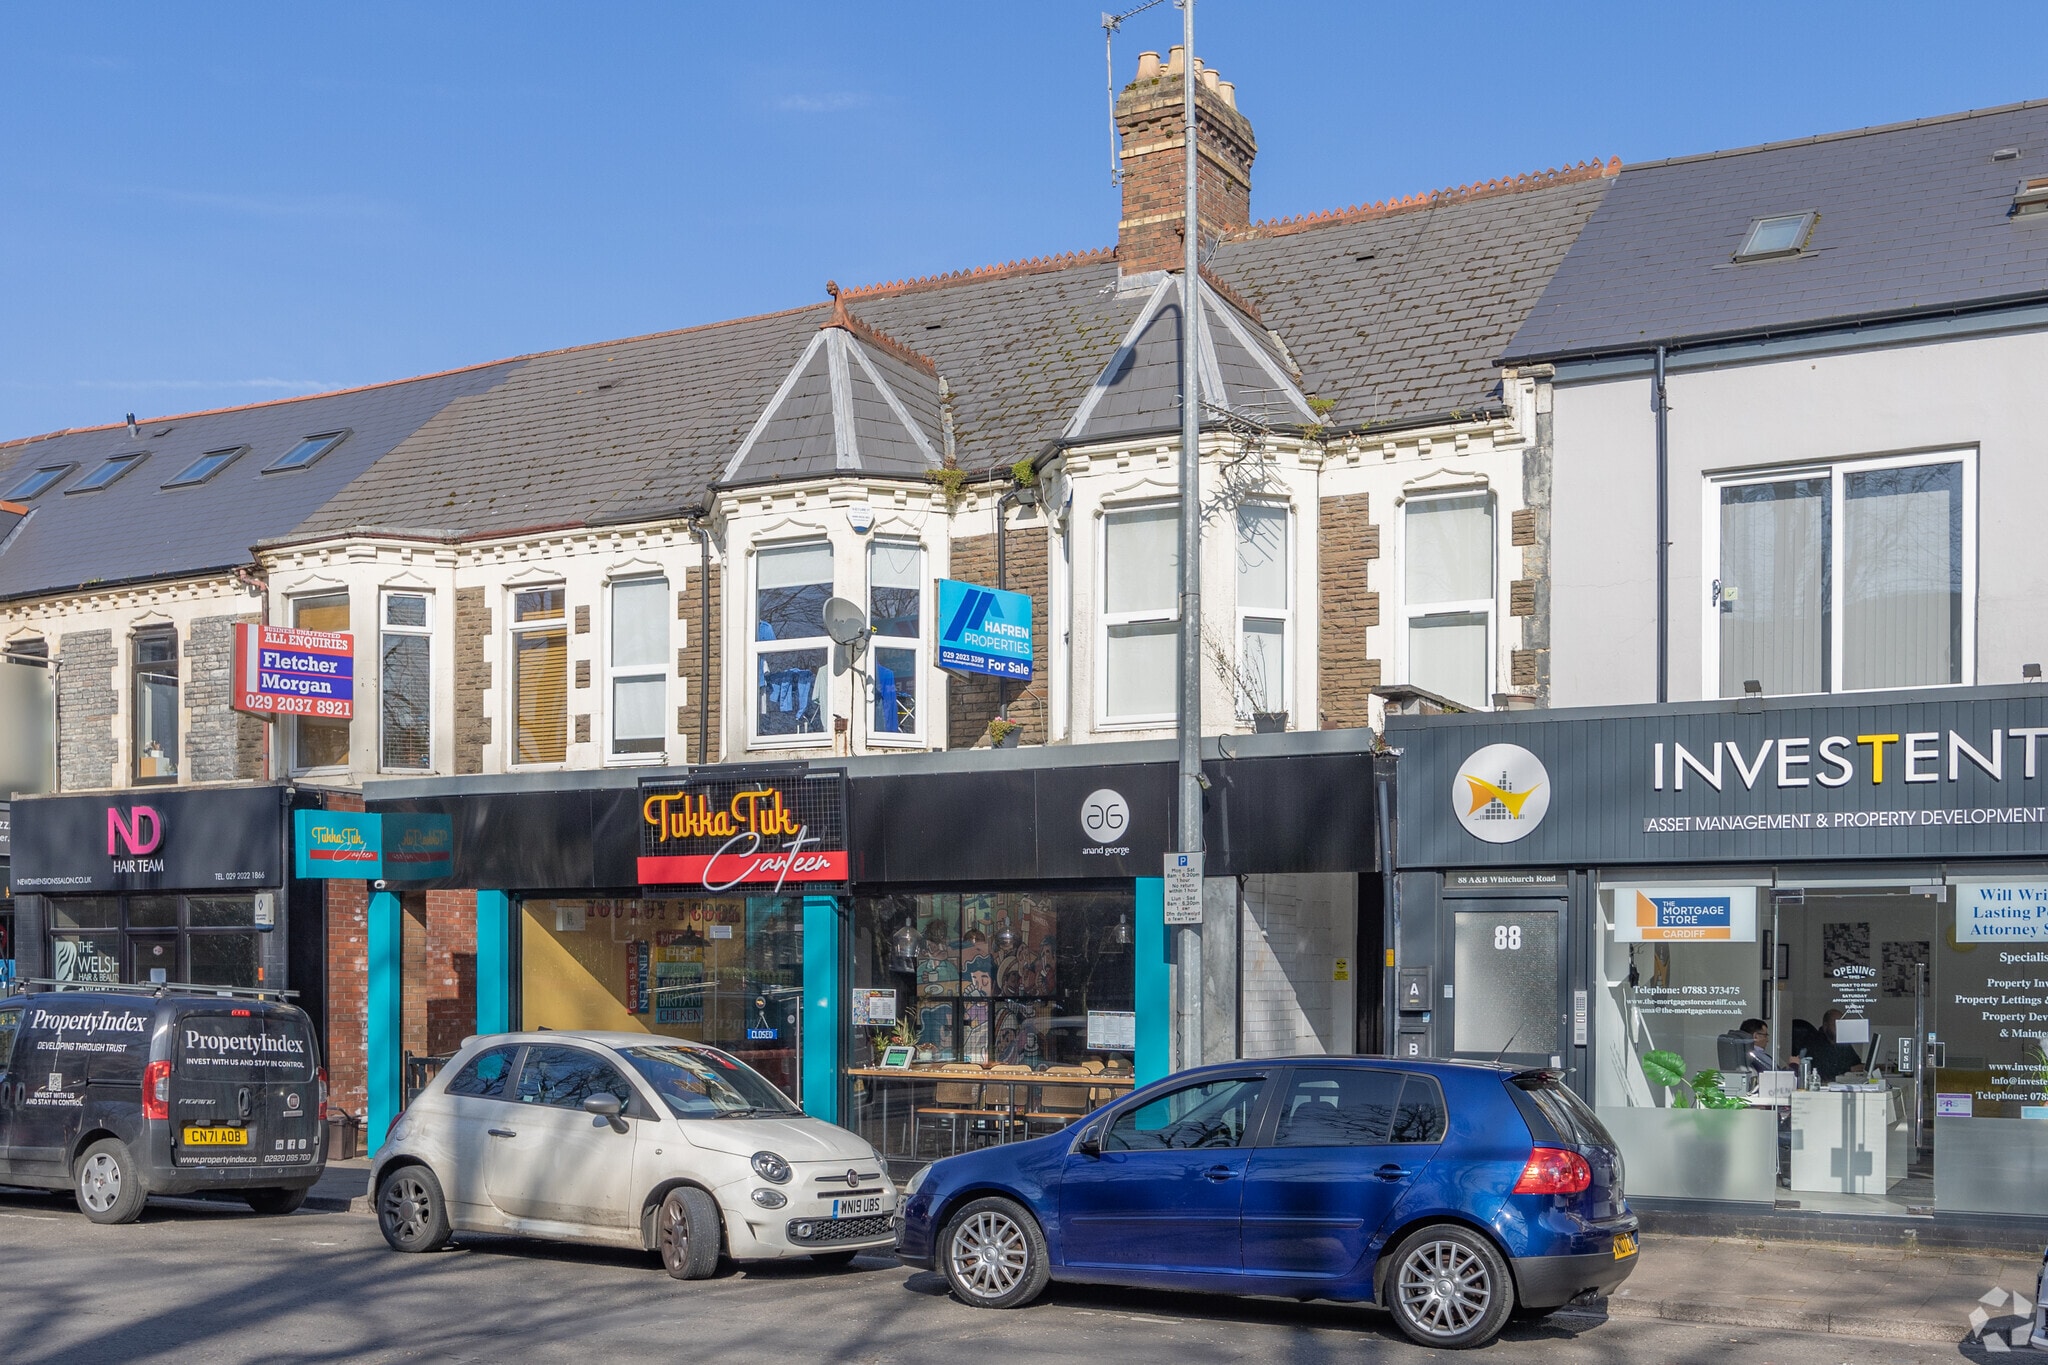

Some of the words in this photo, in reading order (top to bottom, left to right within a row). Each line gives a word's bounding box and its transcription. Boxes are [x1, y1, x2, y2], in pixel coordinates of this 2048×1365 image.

[984, 620, 1029, 639] HAFREN
[265, 632, 286, 644] ALL
[288, 634, 348, 650] ENQUIRIES
[964, 632, 1030, 654] PROPERTIES
[263, 652, 338, 673] Fletcher
[988, 658, 1006, 672] For
[1008, 662, 1029, 675] Sale
[262, 673, 332, 694] Morgan
[246, 694, 272, 709] 029
[277, 697, 312, 712] 2037
[317, 700, 350, 716] 8921
[1654, 728, 2048, 791] INVESTENT
[644, 790, 738, 842] Tukka
[731, 788, 801, 840] Tuk
[1646, 817, 1691, 832] ASSET
[1695, 814, 1810, 831] MANAGEMENT
[1816, 814, 1829, 827] &
[1834, 811, 1917, 827] PROPERTY
[1921, 807, 2046, 825] DEVELOPMENT
[108, 806, 162, 856] ND
[311, 826, 343, 845] Tukka
[341, 828, 363, 845] Tuk
[333, 842, 373, 864] Canteen
[1083, 846, 1103, 855] anand
[1105, 846, 1130, 856] george
[702, 825, 831, 893] Canteen
[113, 859, 136, 874] HAIR
[138, 859, 164, 872] TEAM
[1980, 888, 2012, 900] Will
[2018, 888, 2048, 900] Wri
[1663, 906, 1724, 915] MORTGAGE
[1973, 906, 2030, 920] Lasting
[2036, 906, 2048, 918] P
[1662, 916, 1698, 924] STORE
[1663, 930, 1705, 938] CARDIFF
[1970, 924, 2038, 938] Attorney
[1494, 925, 1521, 950] 88
[78, 941, 94, 953] THE
[79, 973, 92, 982] HAIR
[93, 974, 98, 982] &
[1833, 966, 1876, 977] OPENING
[1409, 983, 1419, 995] A
[1987, 978, 2031, 989] Property
[1633, 986, 1680, 995] Telephone:
[1682, 986, 1707, 994] 07883
[1709, 986, 1740, 994] 373475
[1626, 998, 1747, 1006] www.the-mortgagestorecardiff.co.uk
[1955, 994, 1999, 1005] Property
[2002, 995, 2042, 1006] Lettings
[659, 1009, 701, 1022] CHICKEN
[1982, 1012, 2026, 1022] Property
[31, 1009, 147, 1036] PropertyIndex
[752, 1030, 773, 1038] CLOSED
[2000, 1029, 2009, 1038] &
[2012, 1029, 2048, 1038] Mainte
[37, 1042, 74, 1050] DEVELOPING
[75, 1042, 104, 1052] THROUGH
[106, 1043, 127, 1052] TRUST
[186, 1030, 304, 1056] PropertyIndex
[1409, 1043, 1418, 1055] B
[1989, 1063, 2048, 1071] www.investe
[1976, 1091, 2028, 1101] Telephone:
[192, 1130, 218, 1142] CN71
[221, 1131, 241, 1142] AOB
[180, 1155, 257, 1165] www.propertyindex.co
[841, 1200, 862, 1214] WN19
[864, 1198, 880, 1212] UBS
